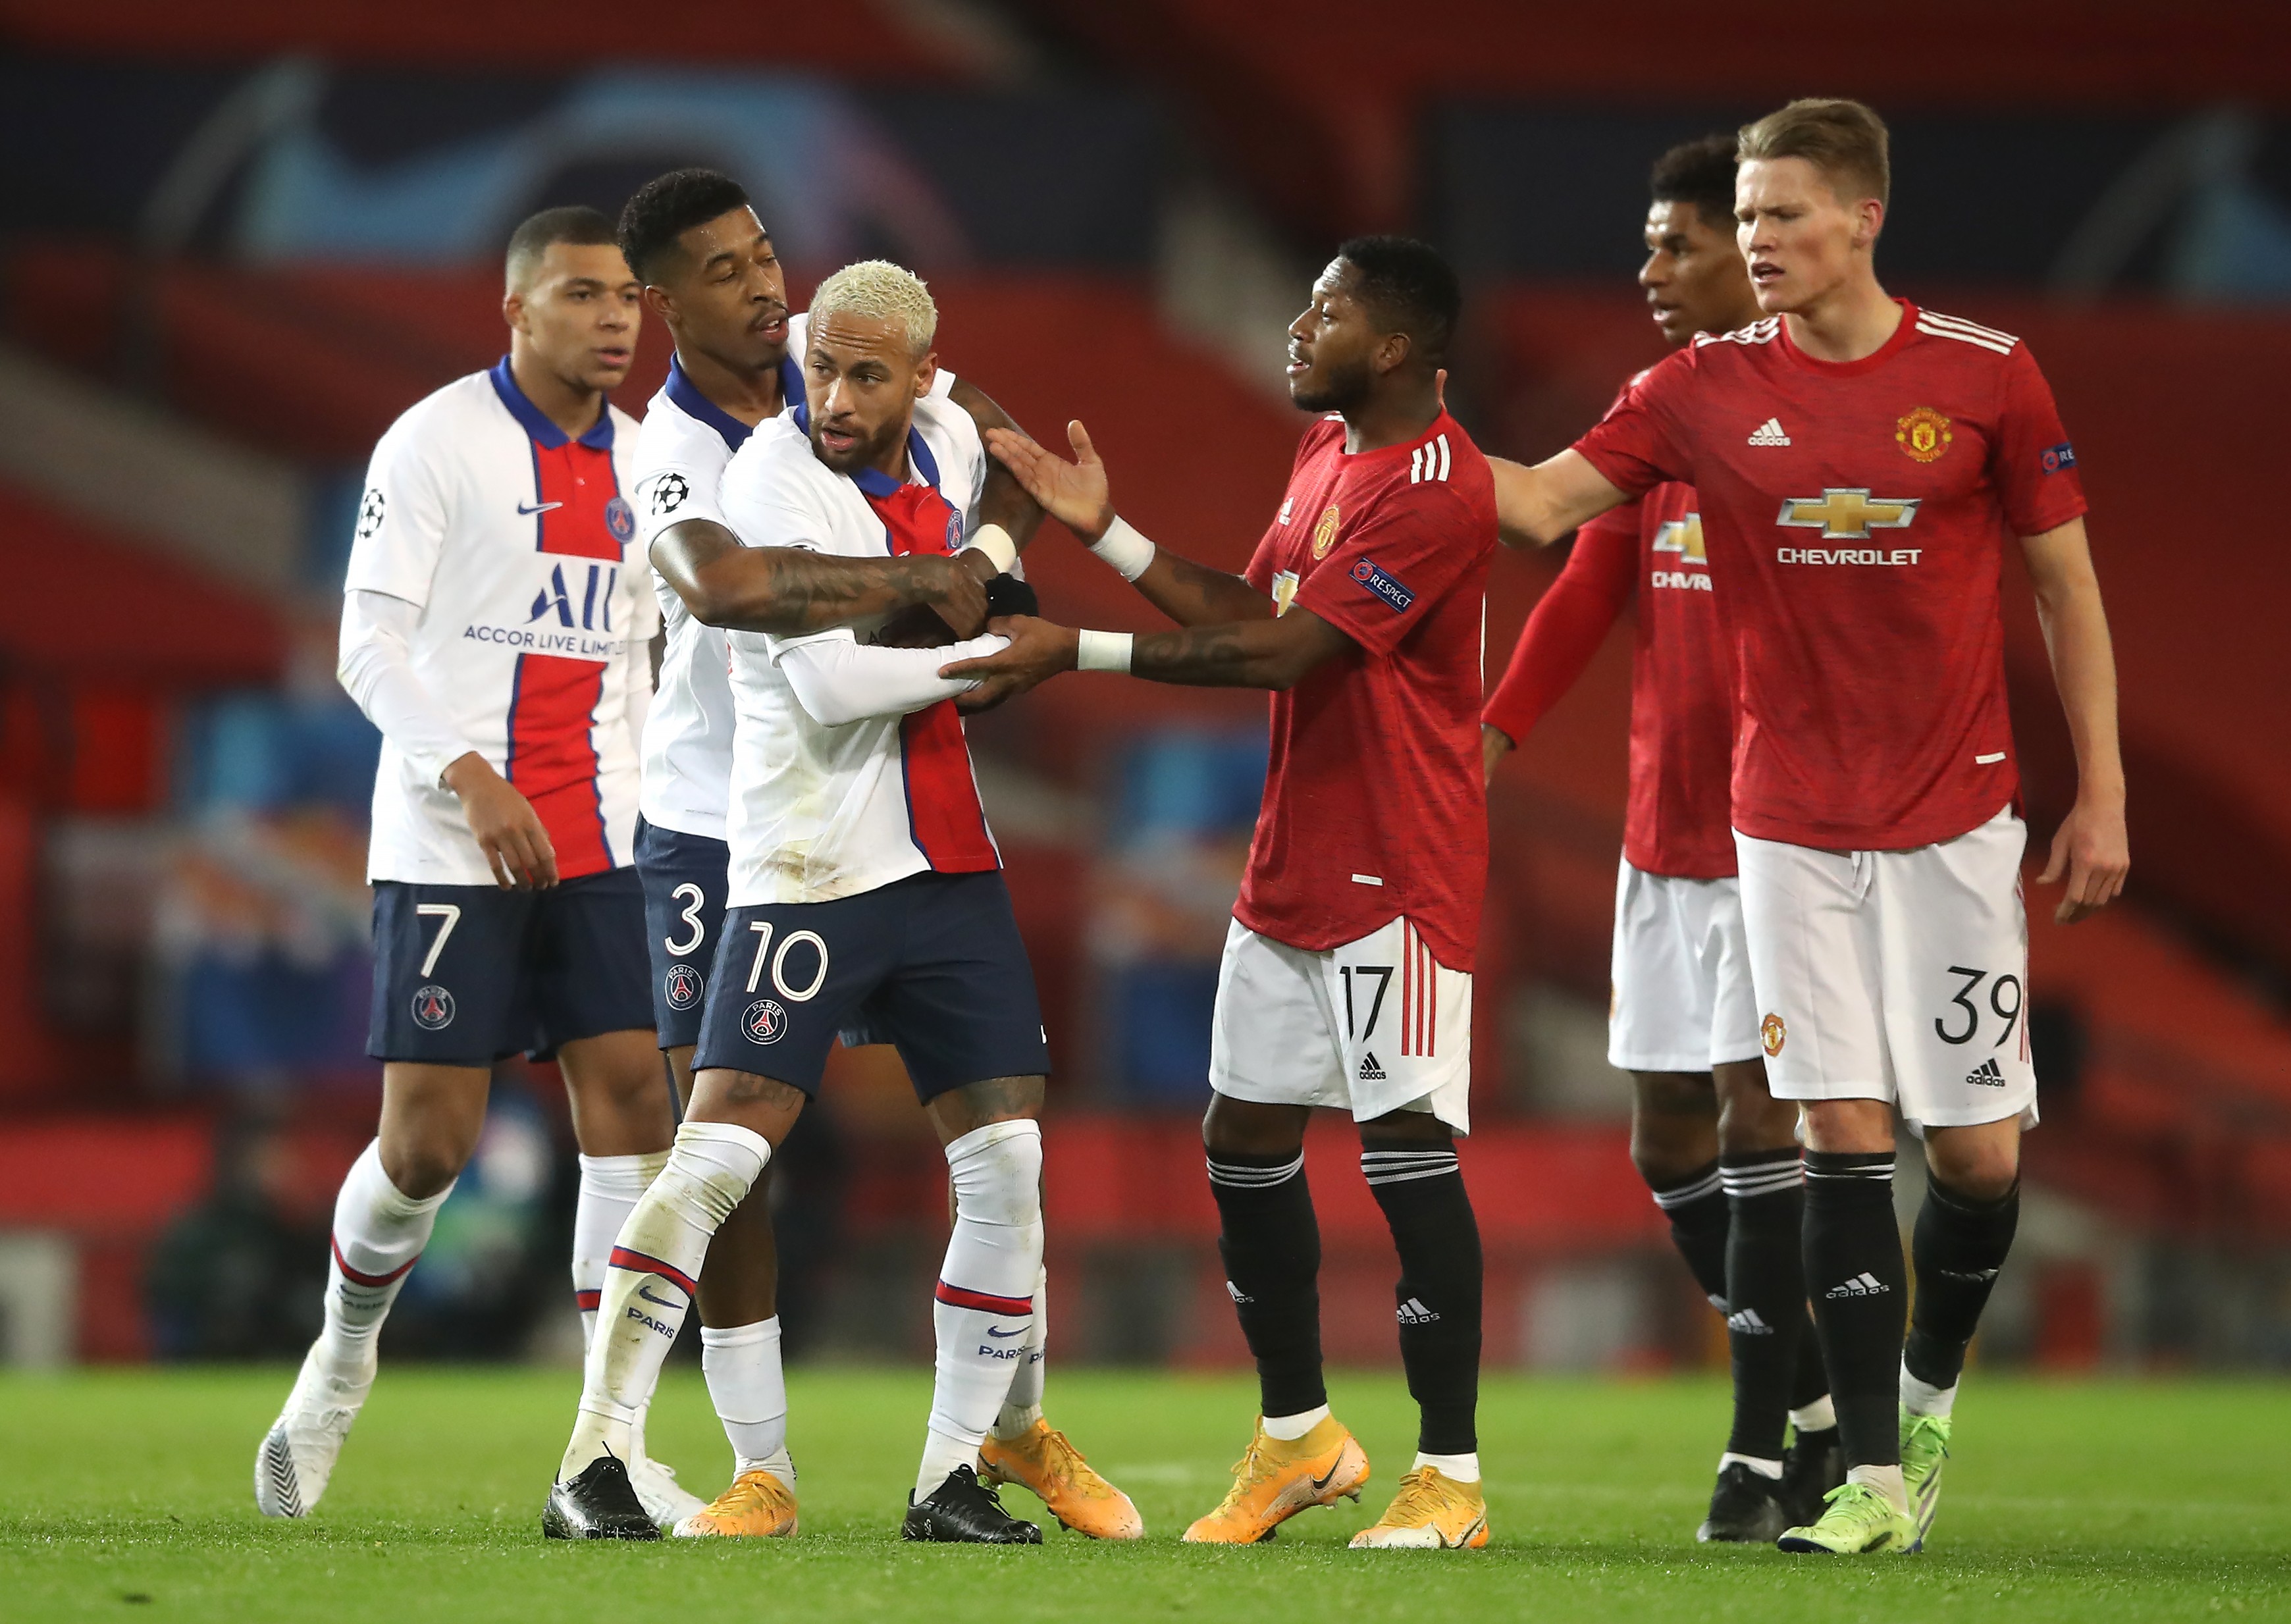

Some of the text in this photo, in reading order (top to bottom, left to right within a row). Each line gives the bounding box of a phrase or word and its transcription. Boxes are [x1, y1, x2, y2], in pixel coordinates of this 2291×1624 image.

[1748, 435, 1791, 446] adidas
[1778, 548, 1922, 565] CHEVROLET
[1370, 573, 1412, 608] RESPECT
[463, 625, 534, 647] ACCOR
[539, 633, 577, 652] LIVE
[664, 883, 705, 956] 3
[416, 903, 461, 978] 7
[668, 966, 695, 980] PARIS
[746, 921, 830, 1002] 10
[752, 1002, 783, 1016] PARIS
[1340, 966, 1394, 1044] 17
[1934, 966, 2021, 1049] 39
[1966, 1073, 2006, 1087] adidas
[1826, 1284, 1890, 1299] adidas
[626, 1306, 675, 1339] PARIS
